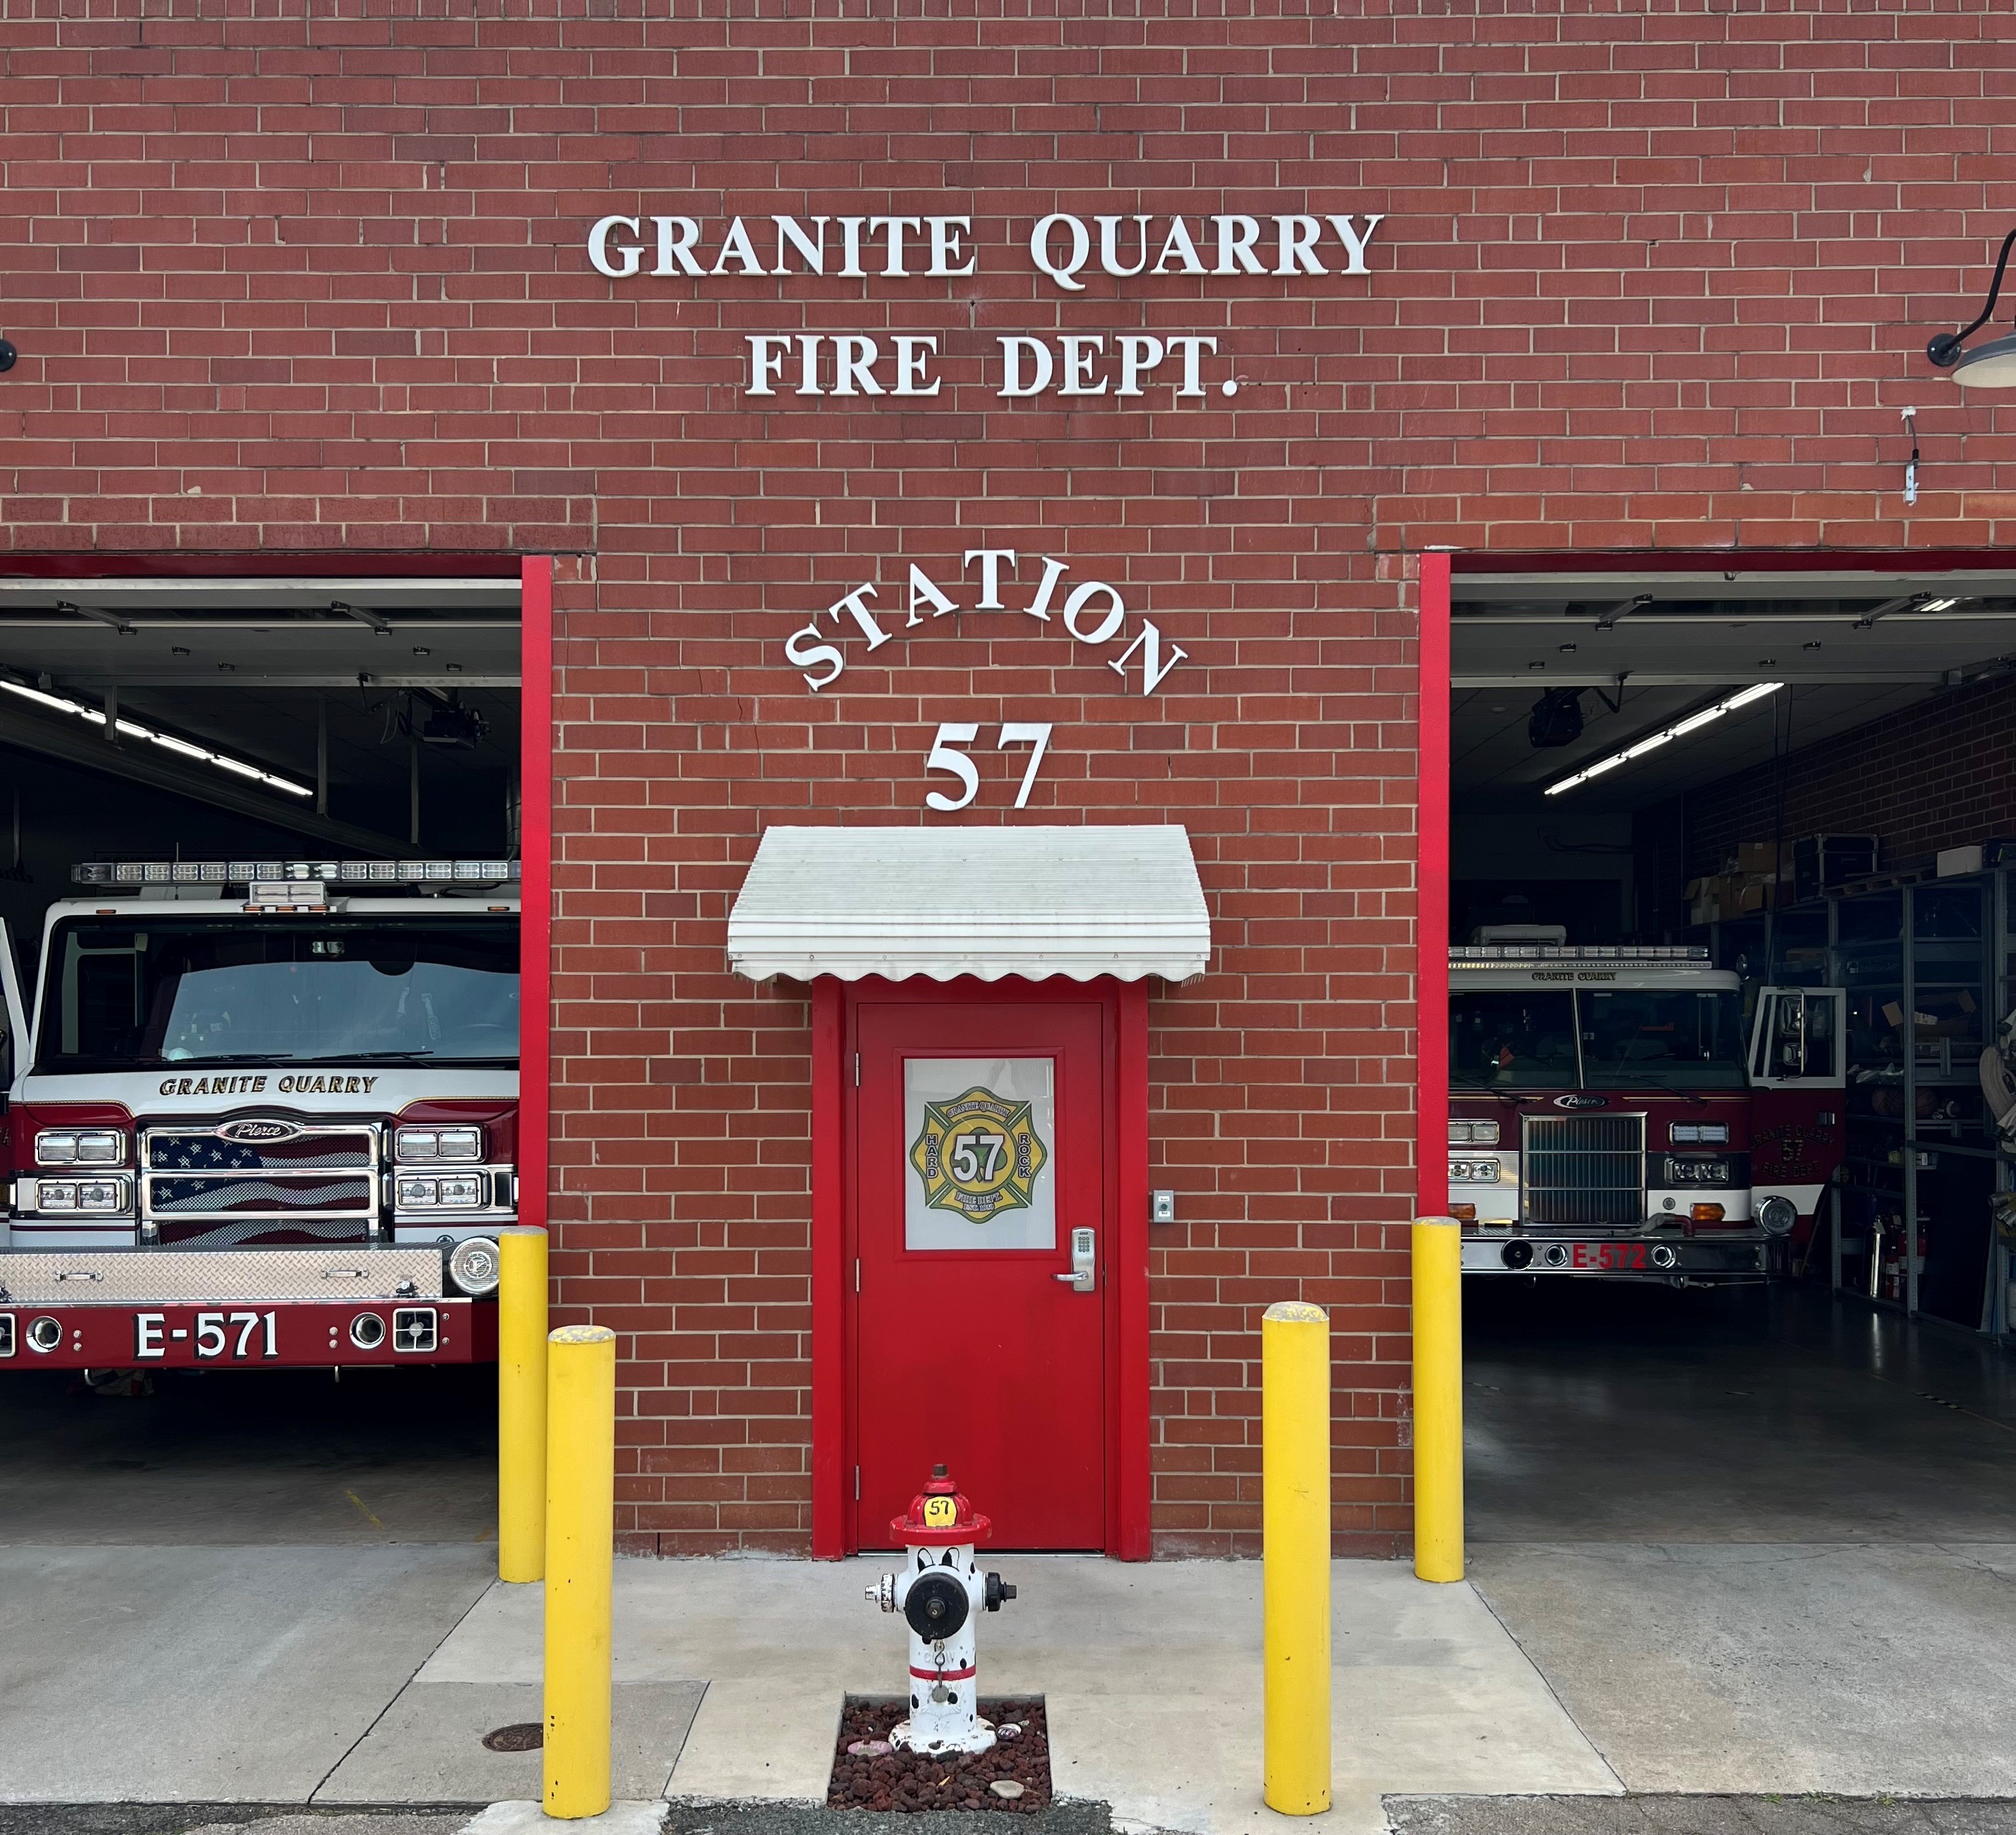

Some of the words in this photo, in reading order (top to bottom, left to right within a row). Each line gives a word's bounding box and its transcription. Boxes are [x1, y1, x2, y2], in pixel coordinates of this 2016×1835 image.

[587, 215, 975, 278] GRANITE
[1030, 213, 1385, 291] QUARRY
[744, 335, 941, 396] FIRE
[997, 336, 1237, 397] DEPT.
[785, 549, 1189, 696] STATION
[926, 723, 1053, 811] 57
[1531, 972, 1574, 981] GRANITE
[1577, 972, 1617, 981] QUARRY
[159, 1076, 267, 1096] GRANITE
[279, 1075, 379, 1094] QUARRY
[235, 1123, 282, 1138] Pierce
[947, 1101, 979, 1118] GRANITE
[979, 1101, 1010, 1118] QUARRY
[926, 1134, 938, 1178] HARD
[953, 1135, 1004, 1182] 57
[1019, 1134, 1031, 1178] ROCK
[955, 1192, 977, 1204] FIRE
[1573, 1244, 1646, 1270] E-572
[133, 1311, 279, 1360] E-571
[929, 1500, 949, 1515] 57
